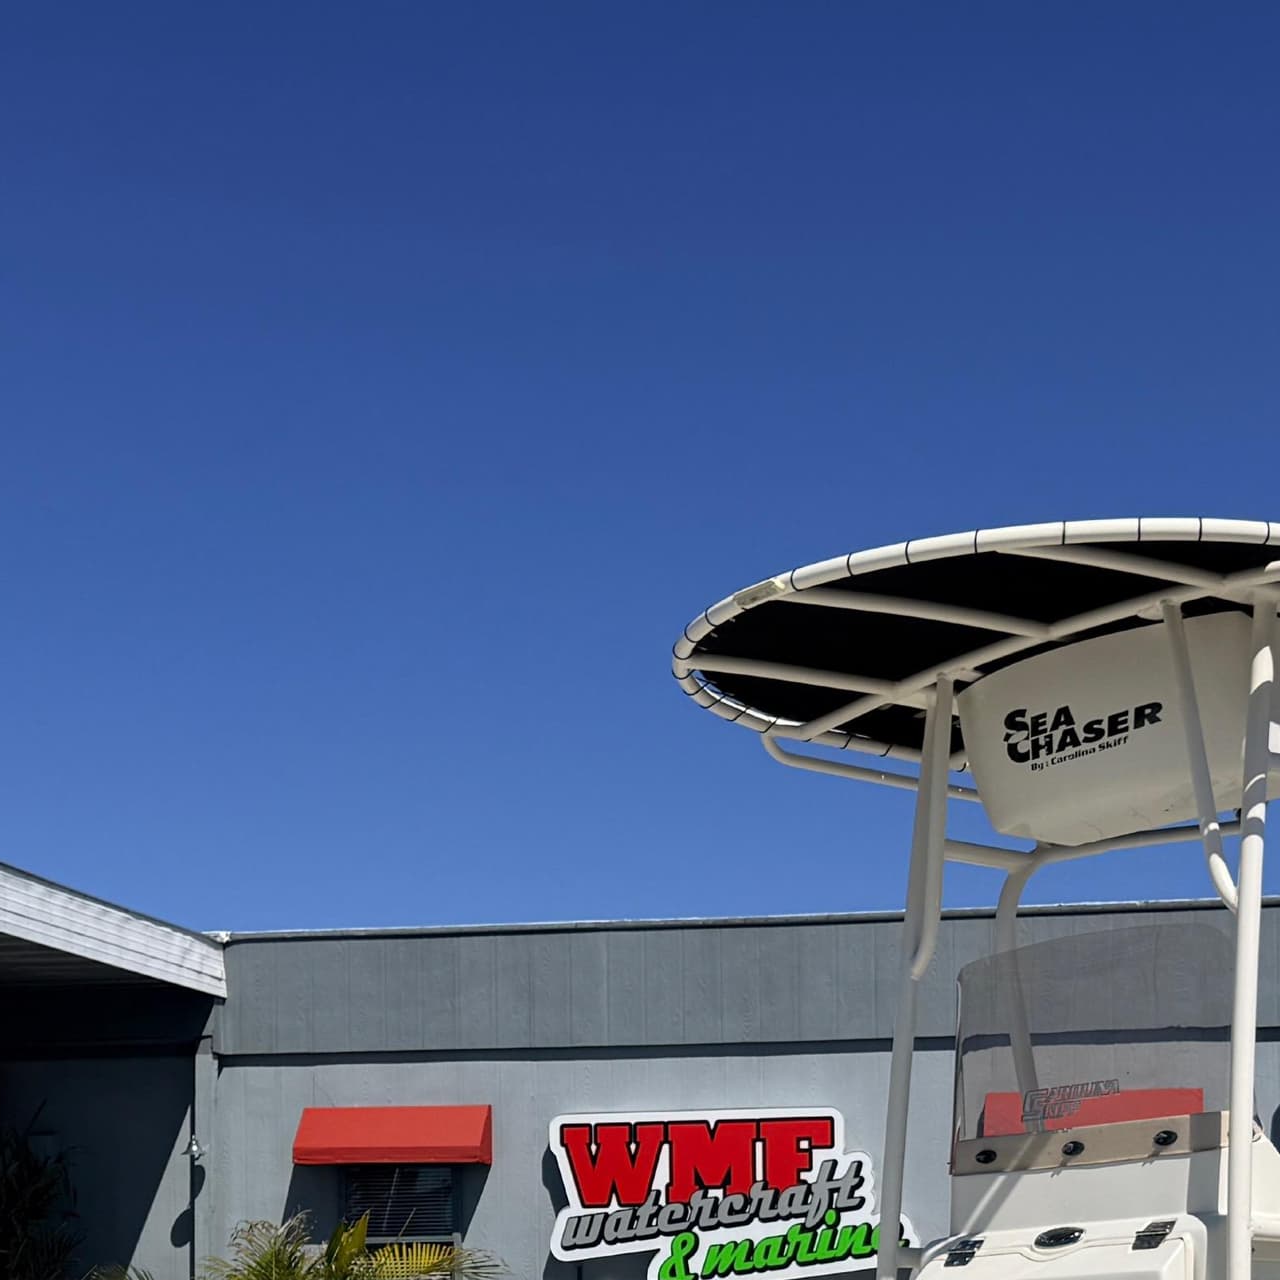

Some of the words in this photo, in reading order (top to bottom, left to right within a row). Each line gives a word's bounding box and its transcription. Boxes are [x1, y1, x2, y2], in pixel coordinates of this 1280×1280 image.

[1004, 705, 1076, 738] SEA
[1006, 702, 1163, 763] CHASER
[1051, 746, 1096, 766] Carolina
[1099, 735, 1129, 751] Skiff
[560, 1116, 835, 1209] WMF
[561, 1159, 866, 1252] watercraft
